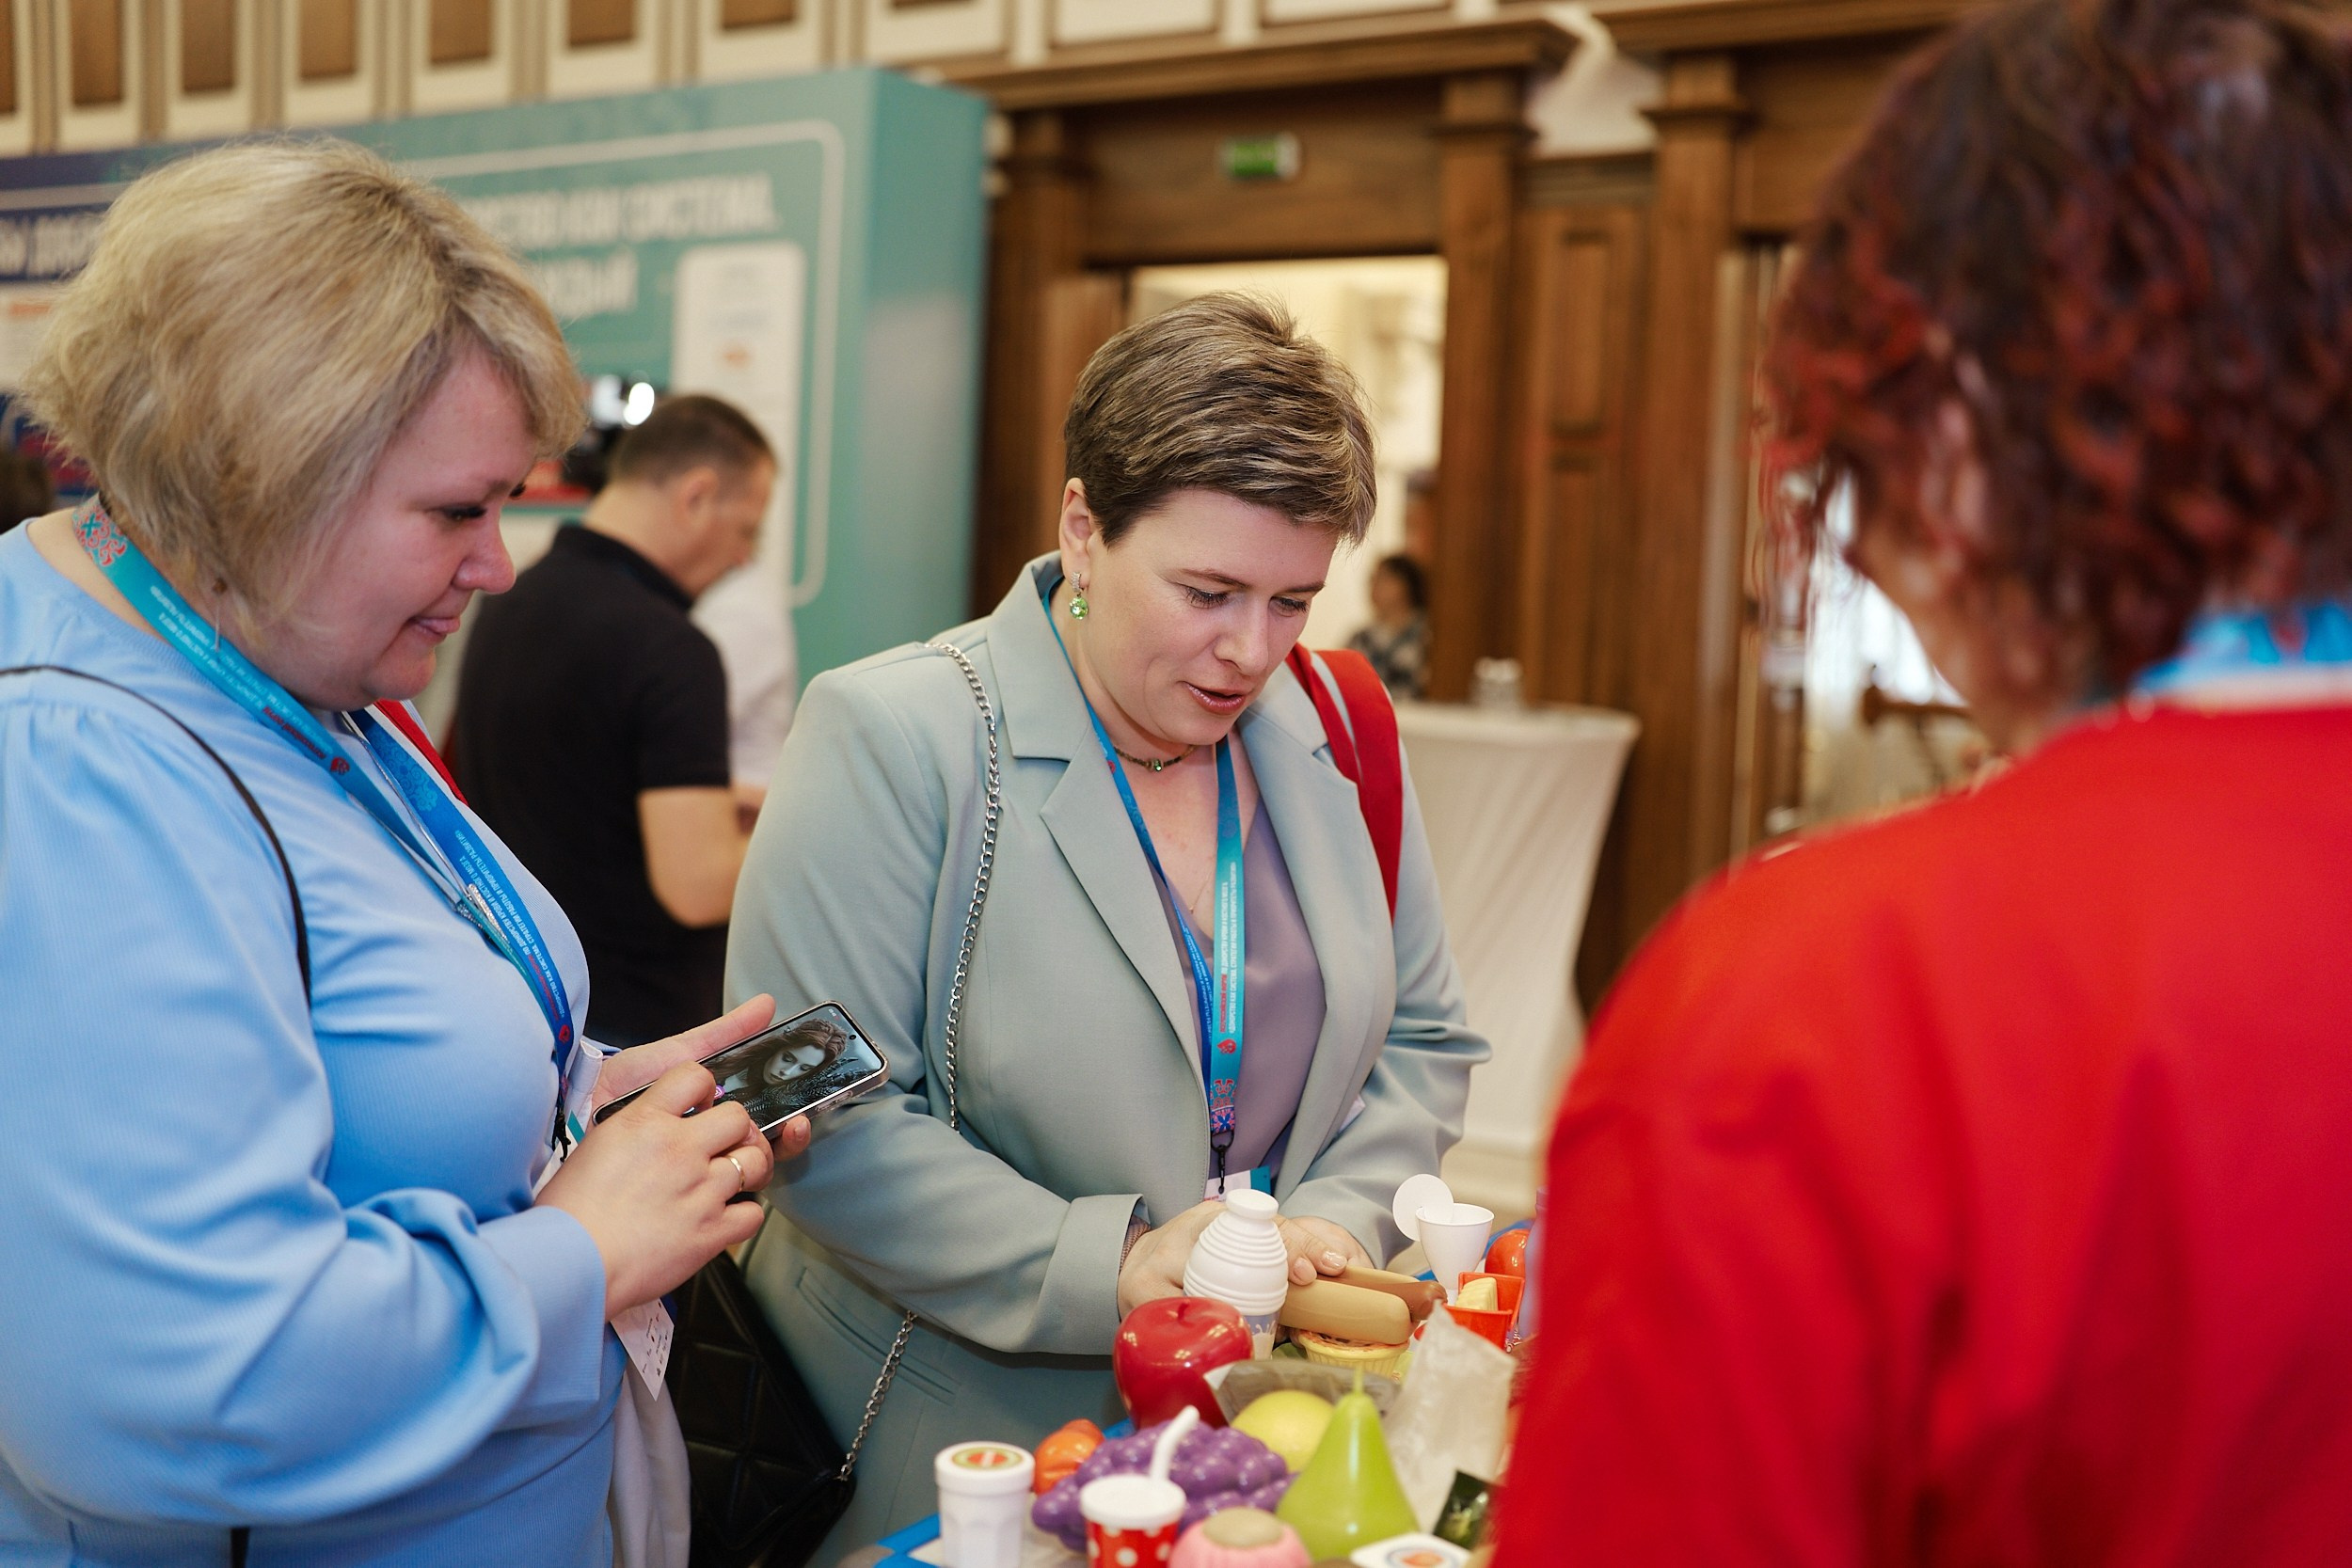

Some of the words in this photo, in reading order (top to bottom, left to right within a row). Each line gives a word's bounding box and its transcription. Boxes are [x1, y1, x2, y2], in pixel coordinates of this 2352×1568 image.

[459, 855, 474, 875] МОЗГА
[474, 857, 500, 891] ПРИОРИТЕТЫ
[470, 872, 491, 898] КОСТНОГО
[491, 901, 506, 919] КРОВИ
[500, 893, 516, 915] РАБОТЫ
[502, 918, 527, 947] ДОНОРСТВУ
[513, 914, 534, 943] СТРАТЕГИИ
[522, 945, 531, 956] ПО
[545, 970, 553, 982] КАК
